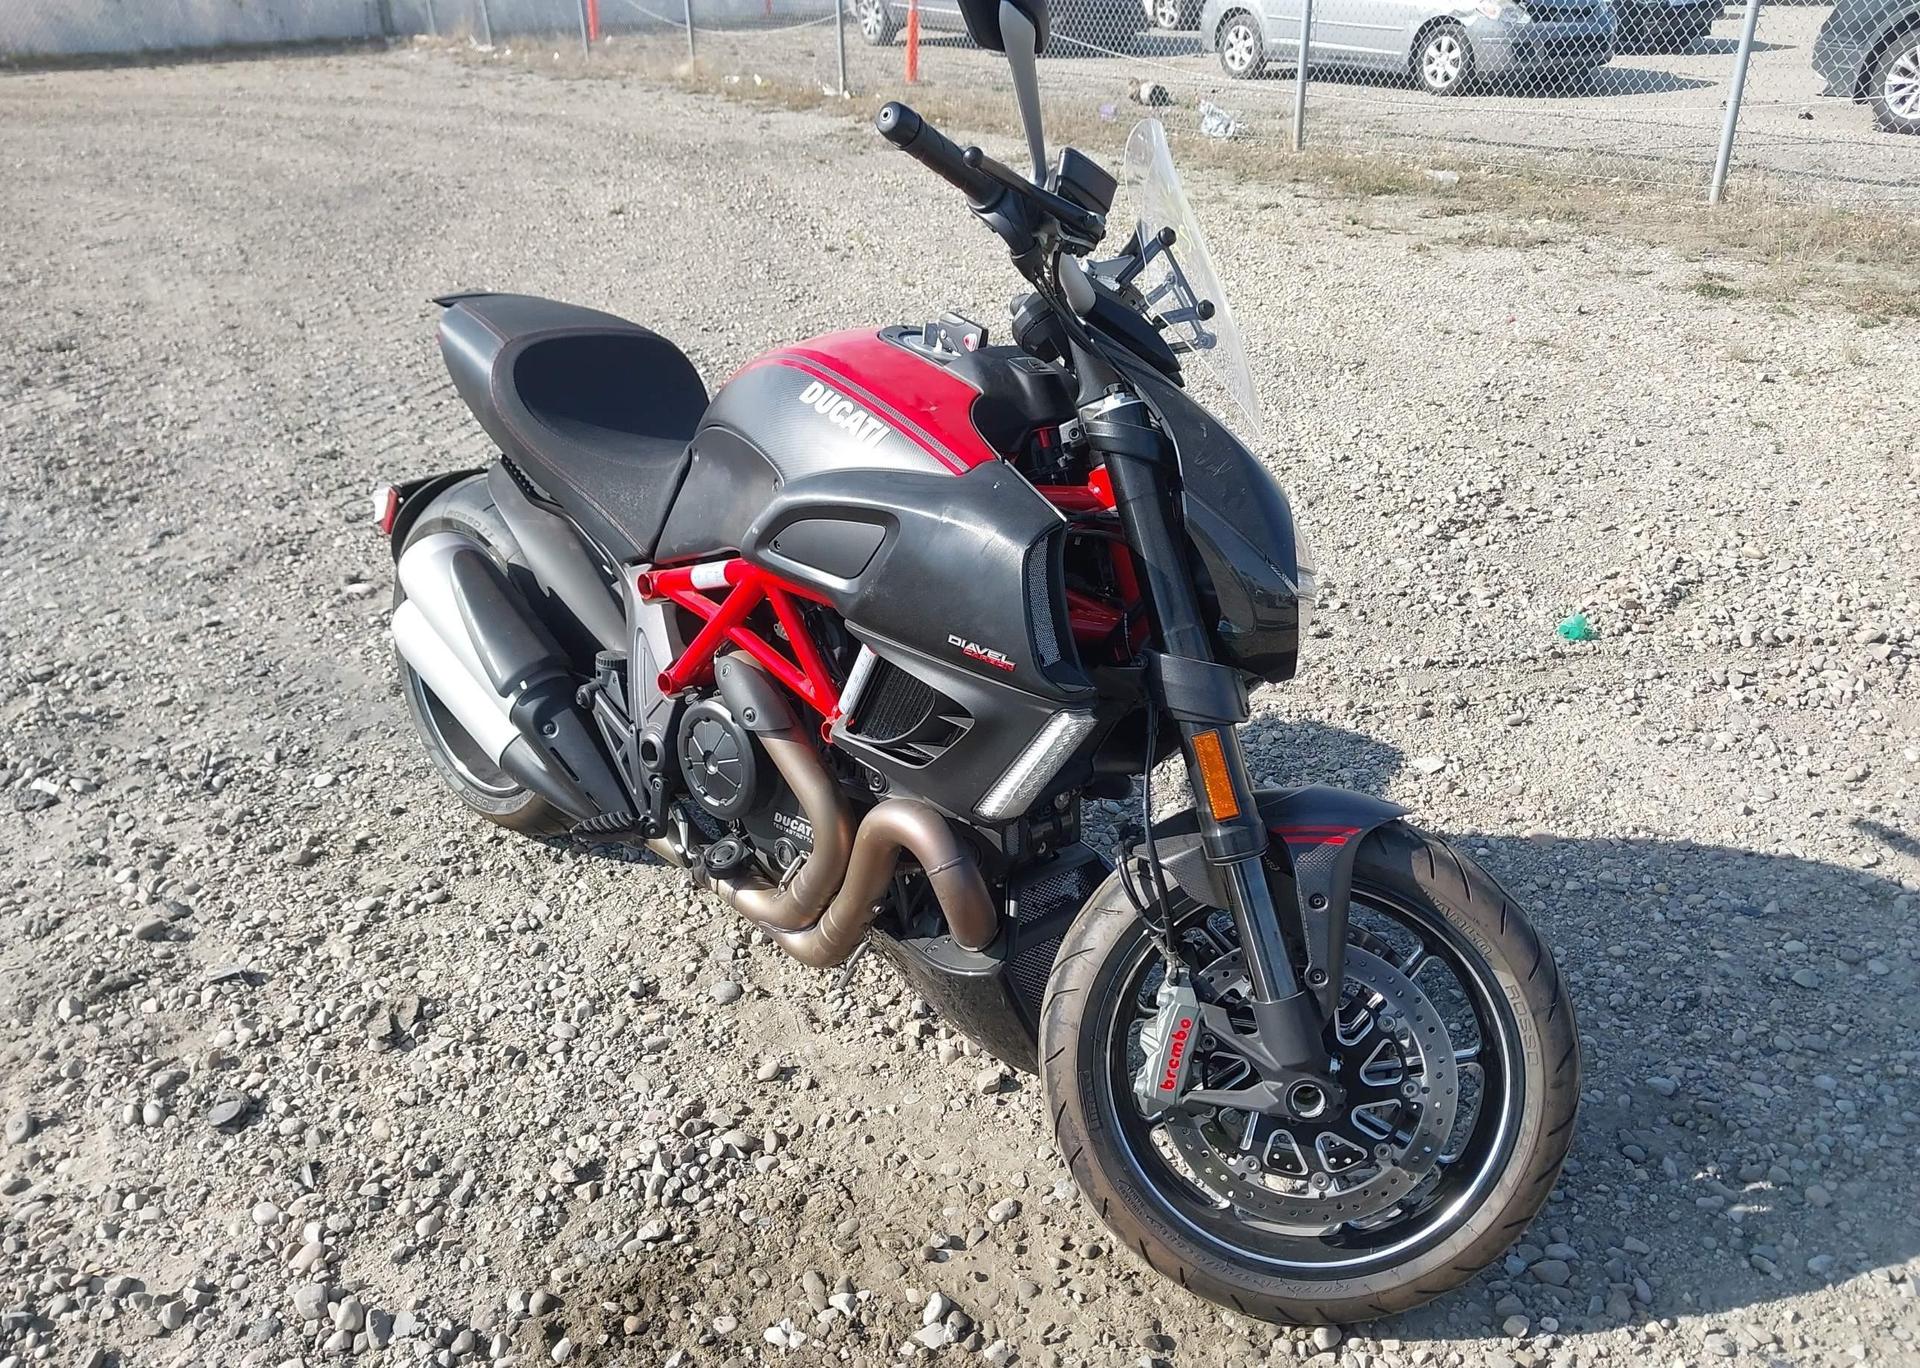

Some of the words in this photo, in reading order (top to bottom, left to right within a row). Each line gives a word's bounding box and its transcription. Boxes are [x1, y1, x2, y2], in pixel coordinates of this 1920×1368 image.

[799, 381, 891, 449] DUCATI
[947, 634, 1016, 664] DIAVEL
[773, 822, 813, 844] TESTASTRETTA
[1160, 1018, 1192, 1091] brembo
[1504, 984, 1539, 1066] ROSSO
